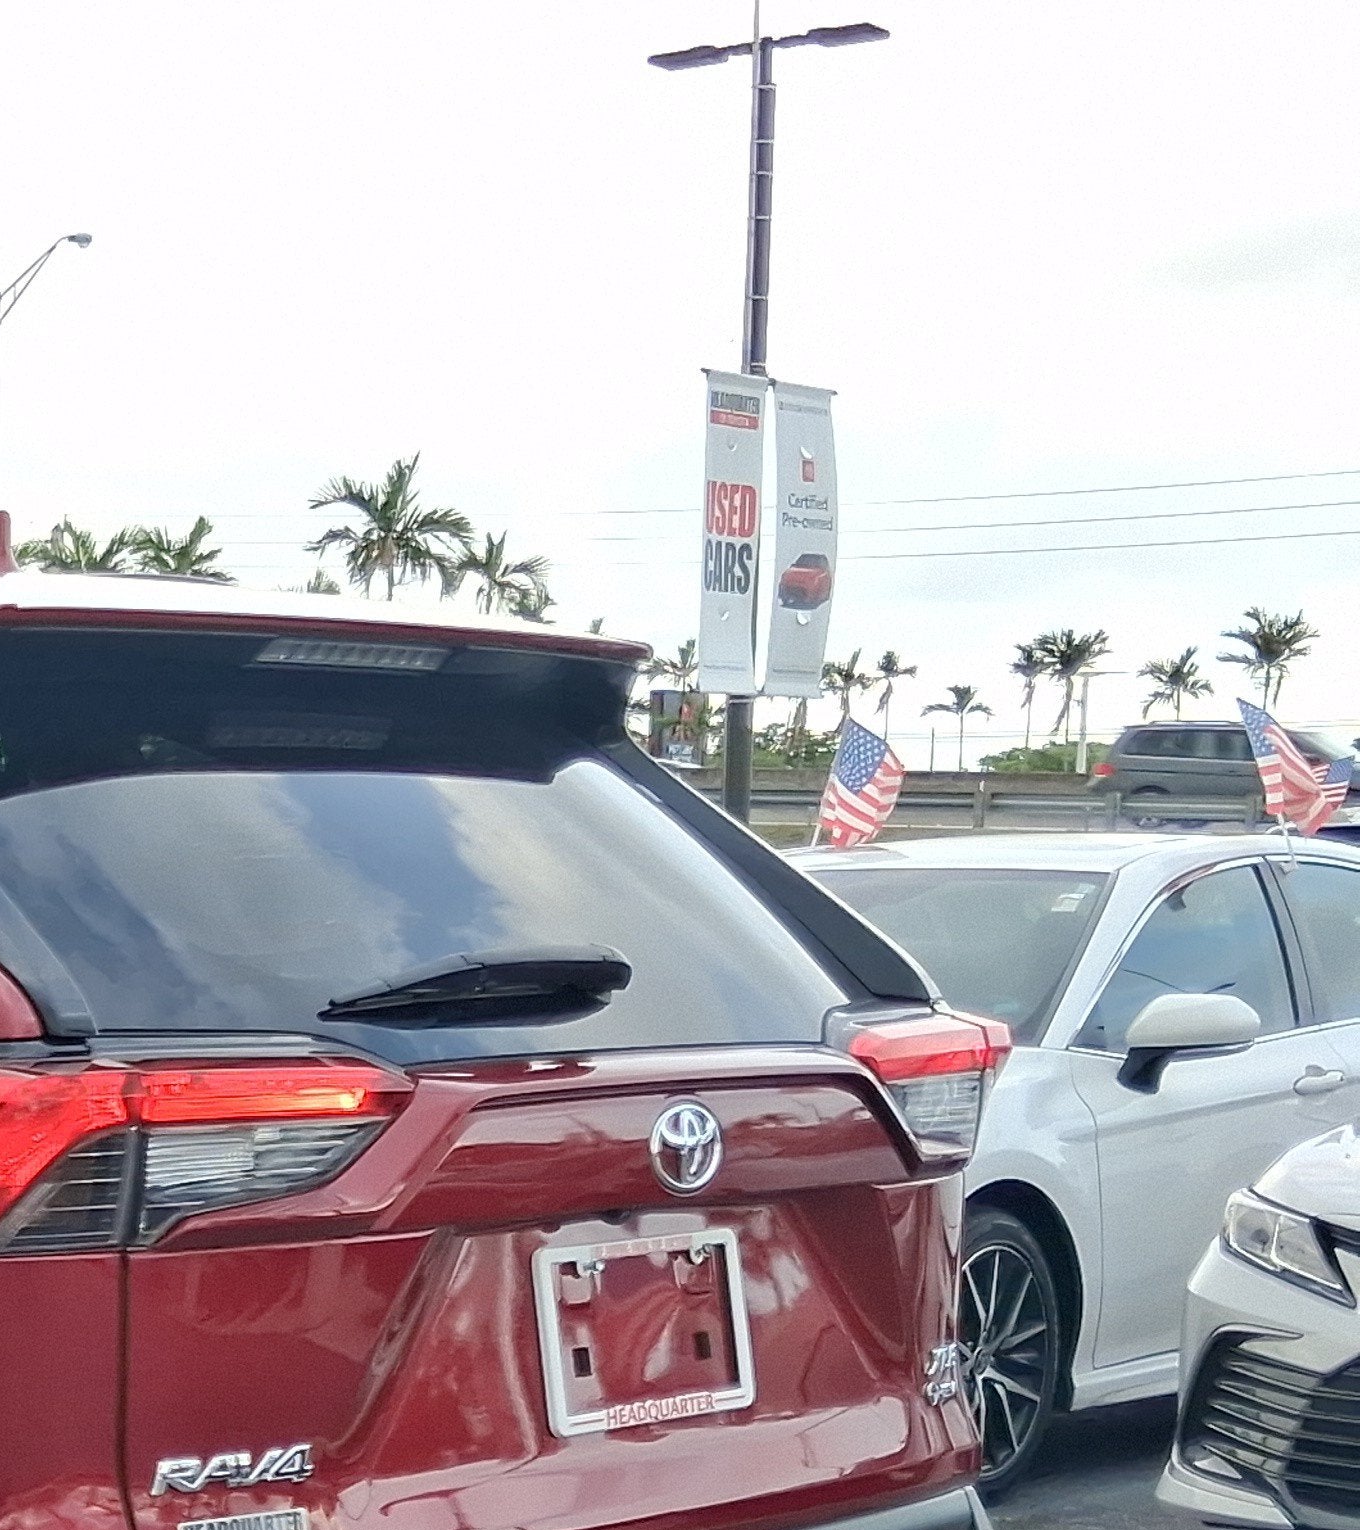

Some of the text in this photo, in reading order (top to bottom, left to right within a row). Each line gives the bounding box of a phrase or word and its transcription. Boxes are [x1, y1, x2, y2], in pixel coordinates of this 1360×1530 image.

[706, 480, 757, 538] USED
[704, 537, 753, 595] CARS
[606, 1394, 716, 1428] HEADQUARTER
[150, 1442, 316, 1497] RAV4
